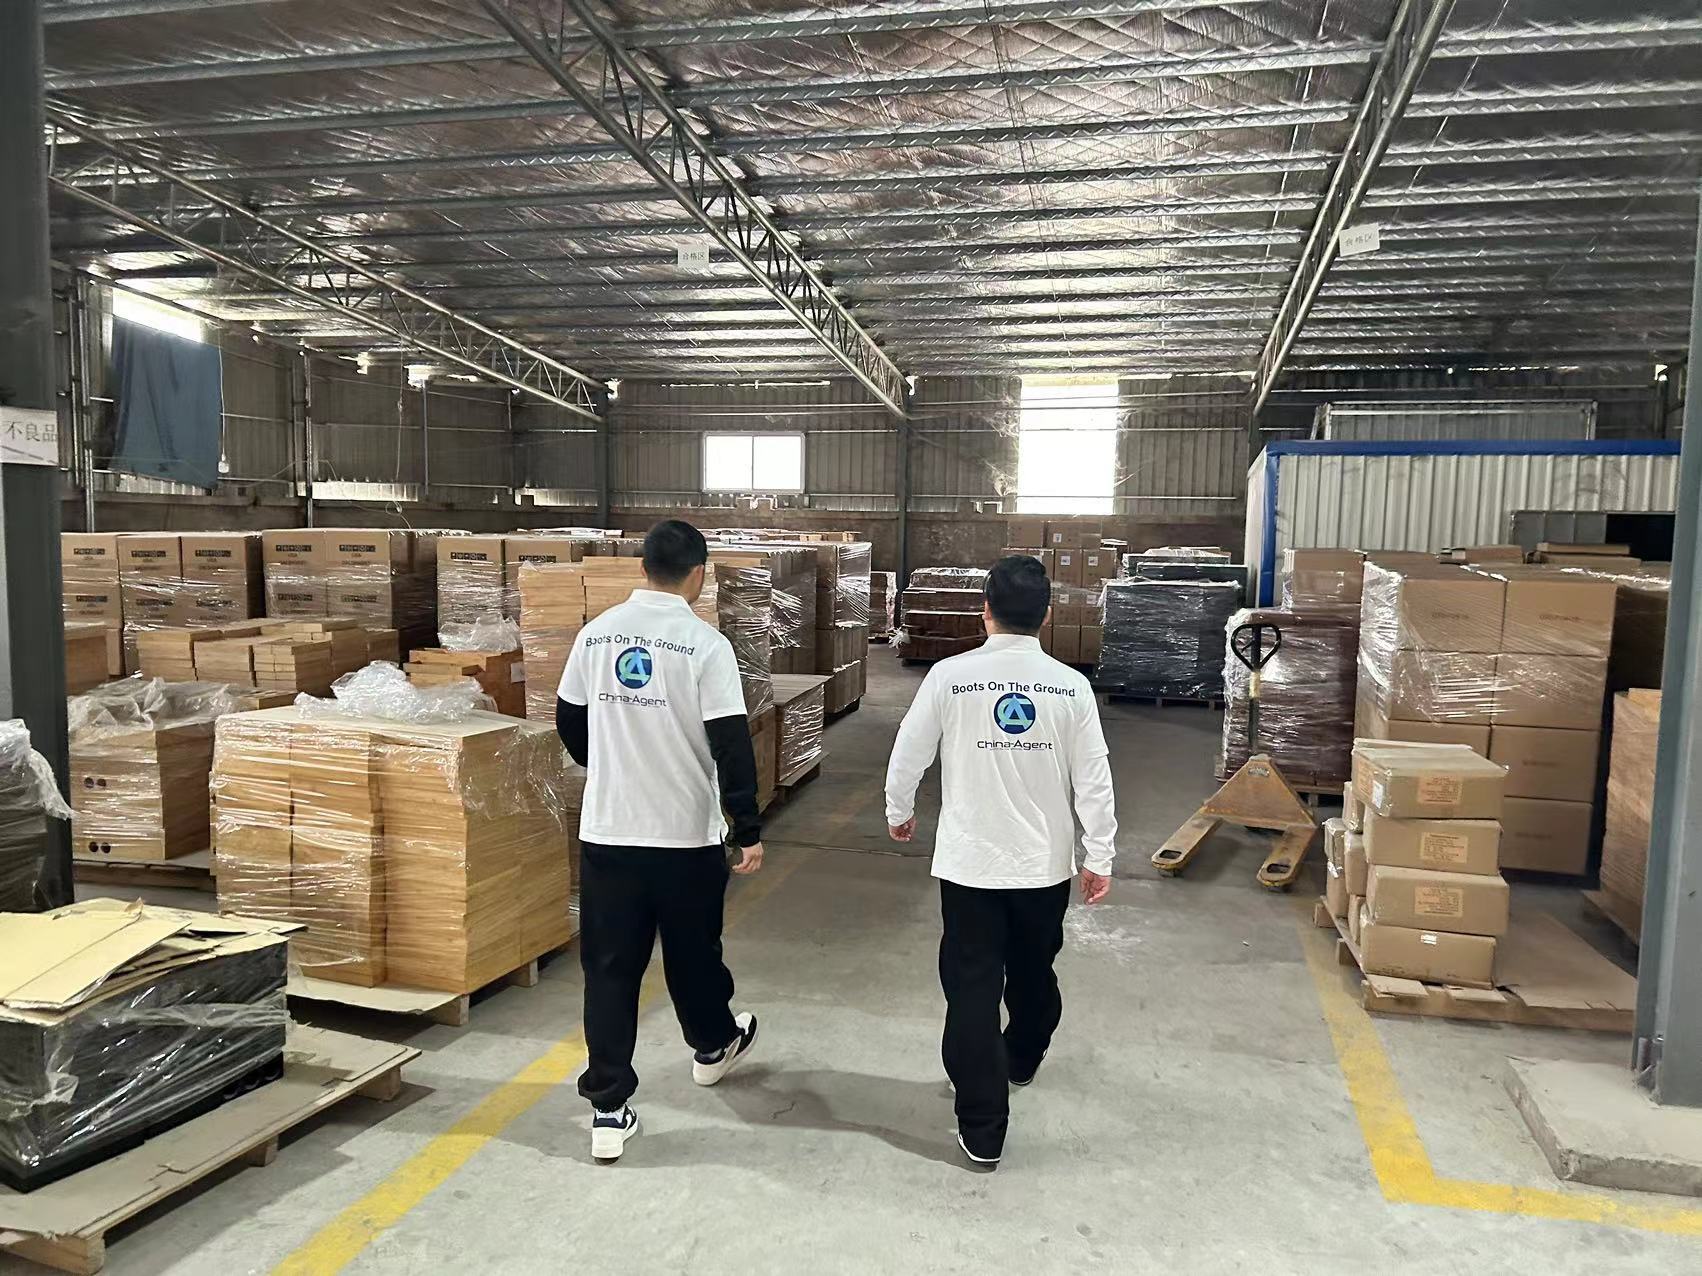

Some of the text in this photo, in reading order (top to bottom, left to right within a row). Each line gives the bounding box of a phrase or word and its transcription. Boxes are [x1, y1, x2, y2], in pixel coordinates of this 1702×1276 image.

[2, 421, 58, 442] 不良品
[586, 634, 695, 656] Boots On The Ground
[952, 681, 1076, 697] Boots On The Ground
[598, 692, 667, 707] China-Agent
[976, 739, 1053, 751] China-Agent
